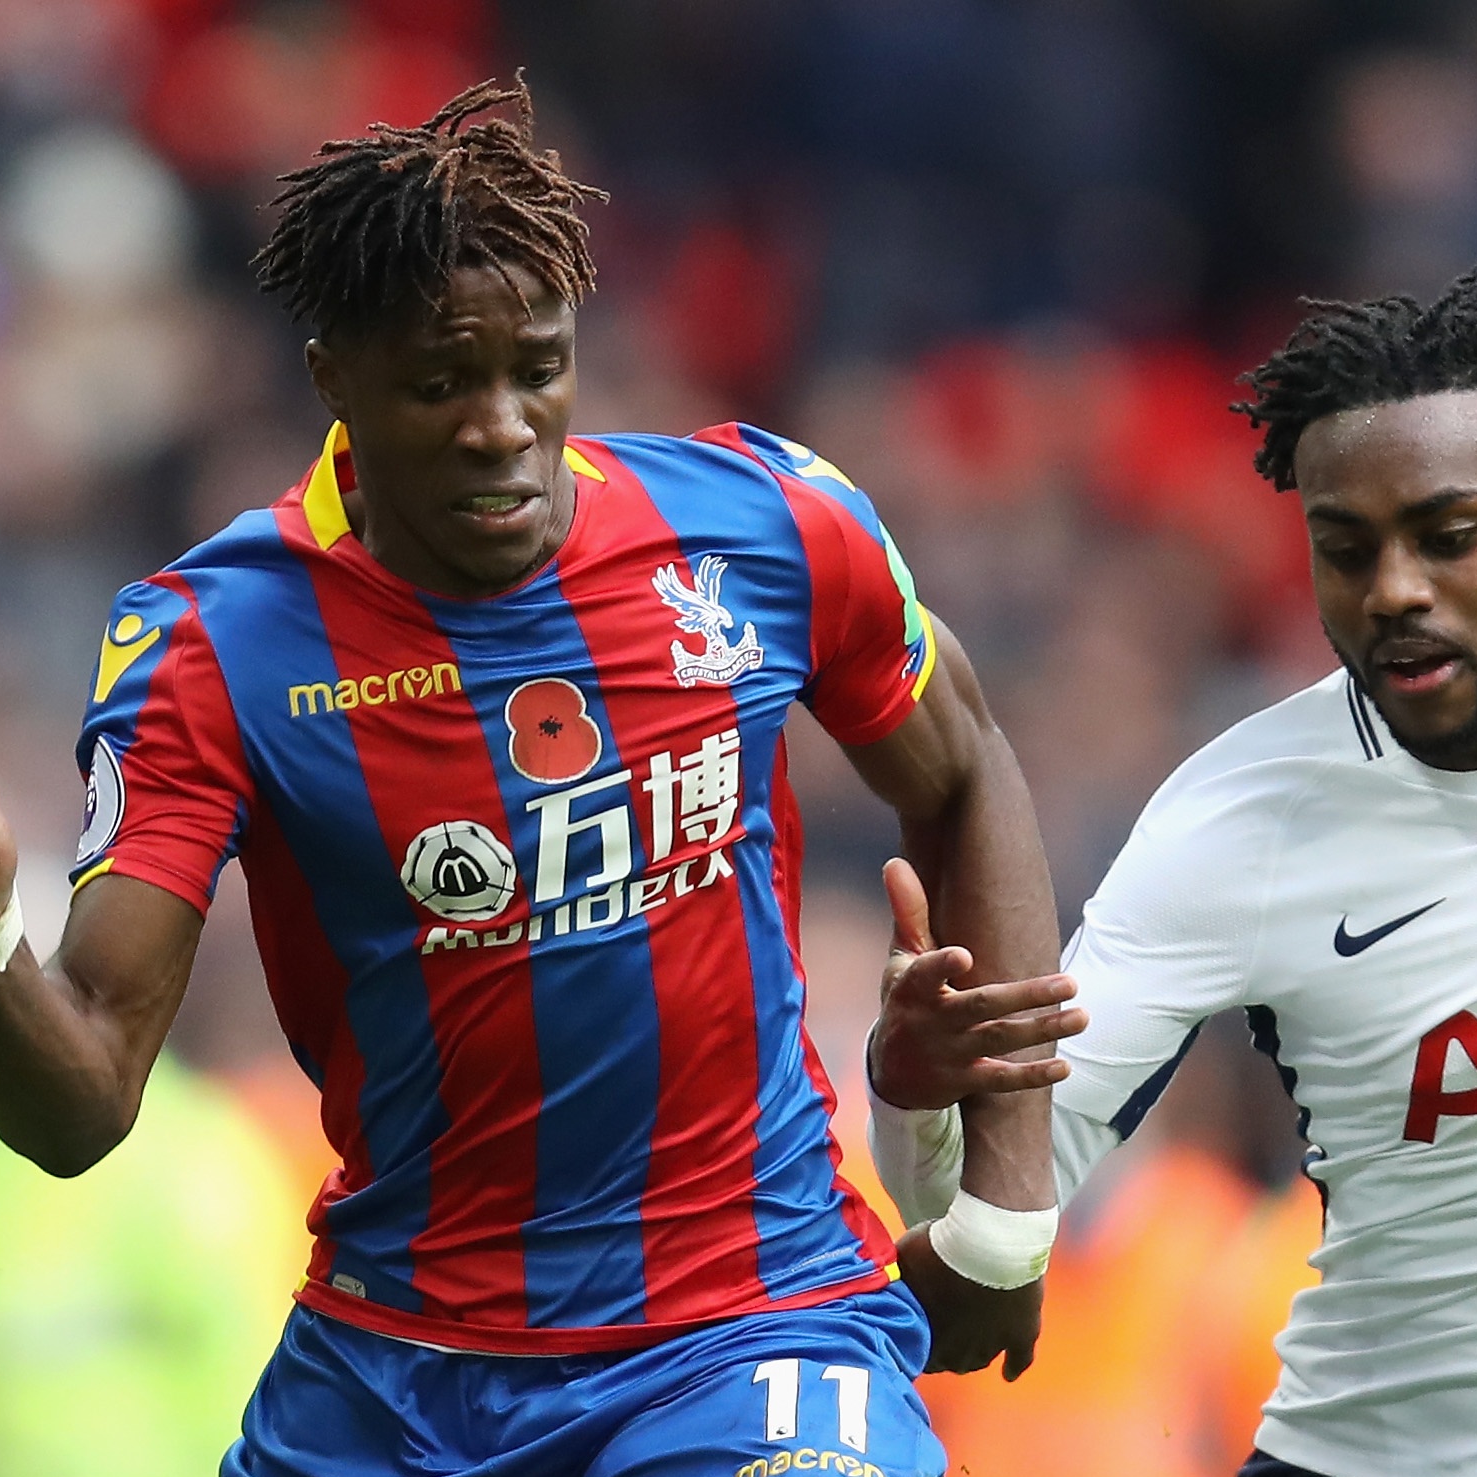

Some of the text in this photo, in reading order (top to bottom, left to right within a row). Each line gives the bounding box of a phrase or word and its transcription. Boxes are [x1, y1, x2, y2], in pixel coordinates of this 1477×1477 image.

[289, 662, 461, 718] macron
[680, 667, 718, 680] CRYSTAL
[526, 728, 741, 903] 万博
[752, 1358, 870, 1454] 11
